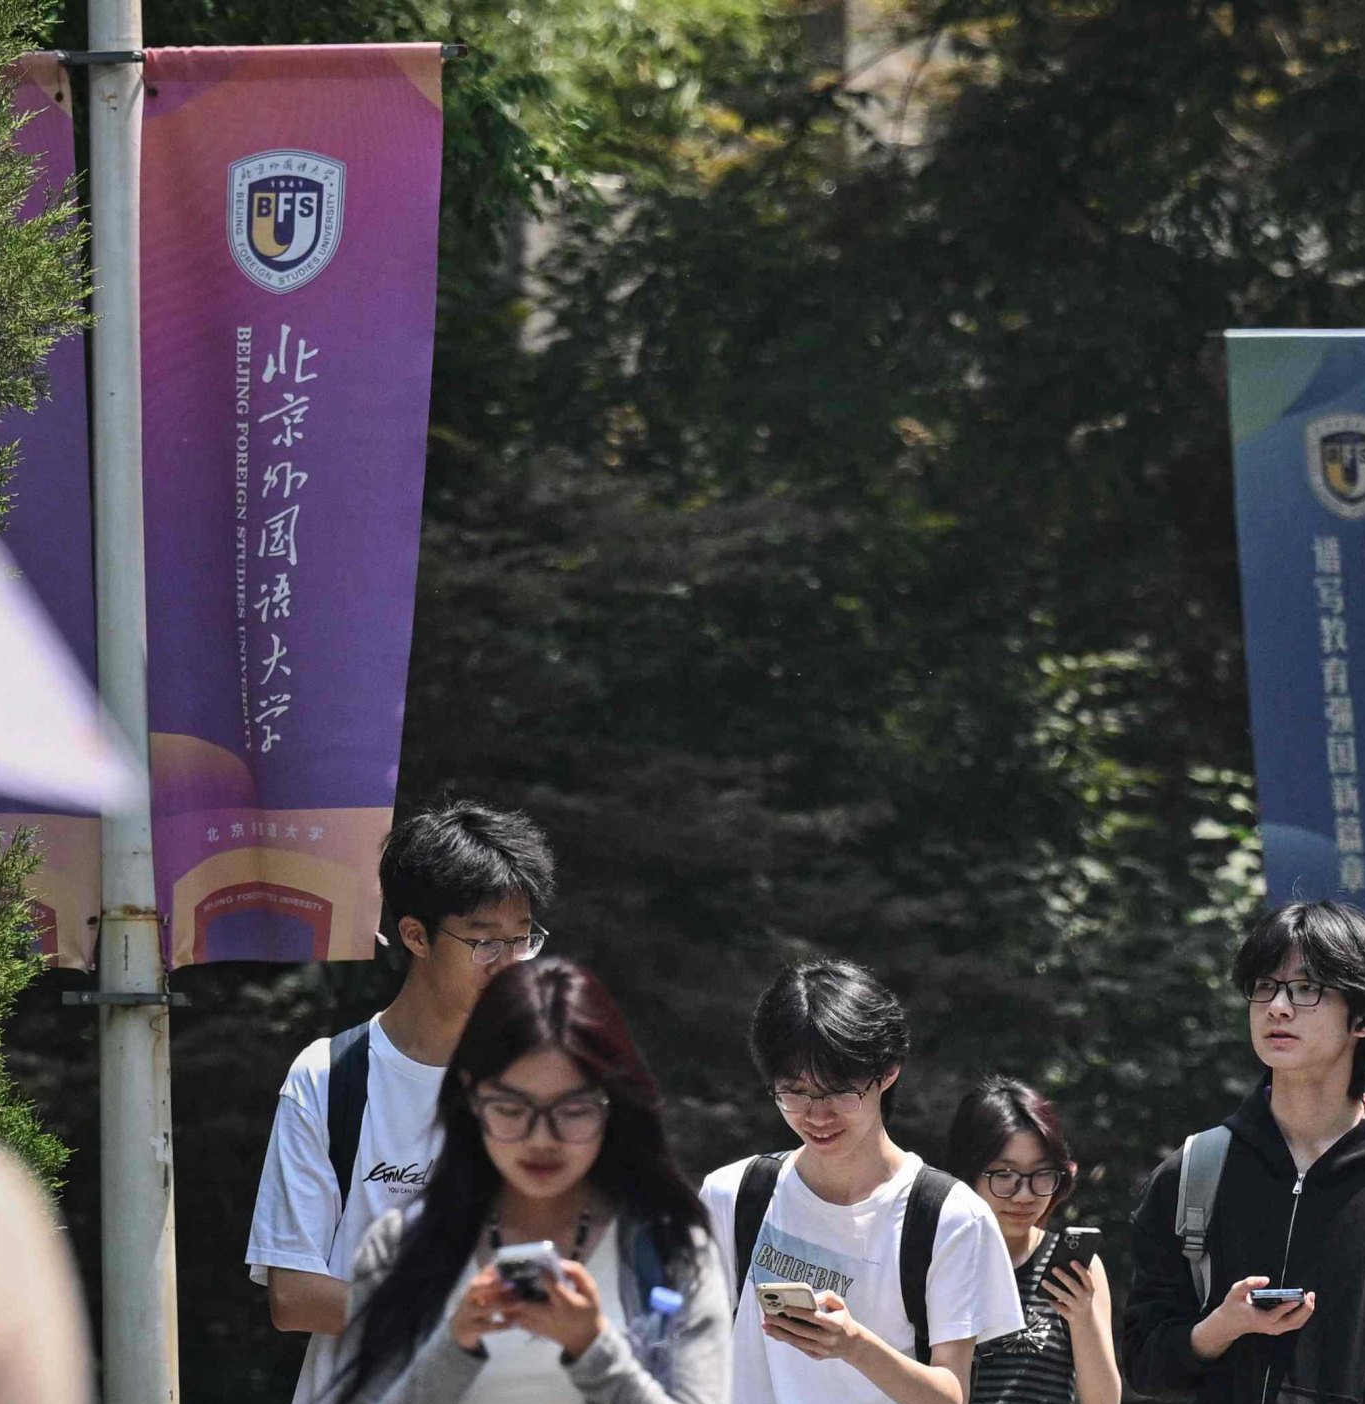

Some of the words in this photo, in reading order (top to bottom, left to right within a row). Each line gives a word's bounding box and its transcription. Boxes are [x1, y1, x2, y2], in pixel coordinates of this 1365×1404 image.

[235, 191, 245, 236] BEIJING
[319, 192, 336, 257] UNIVERSITY
[238, 242, 274, 281] FOREIGN
[278, 257, 321, 286] STUDIES
[236, 326, 252, 416] BEIJING
[236, 422, 249, 521] FOREIGN
[236, 526, 247, 619] STUDIES
[254, 324, 319, 754] 北京外国语大学
